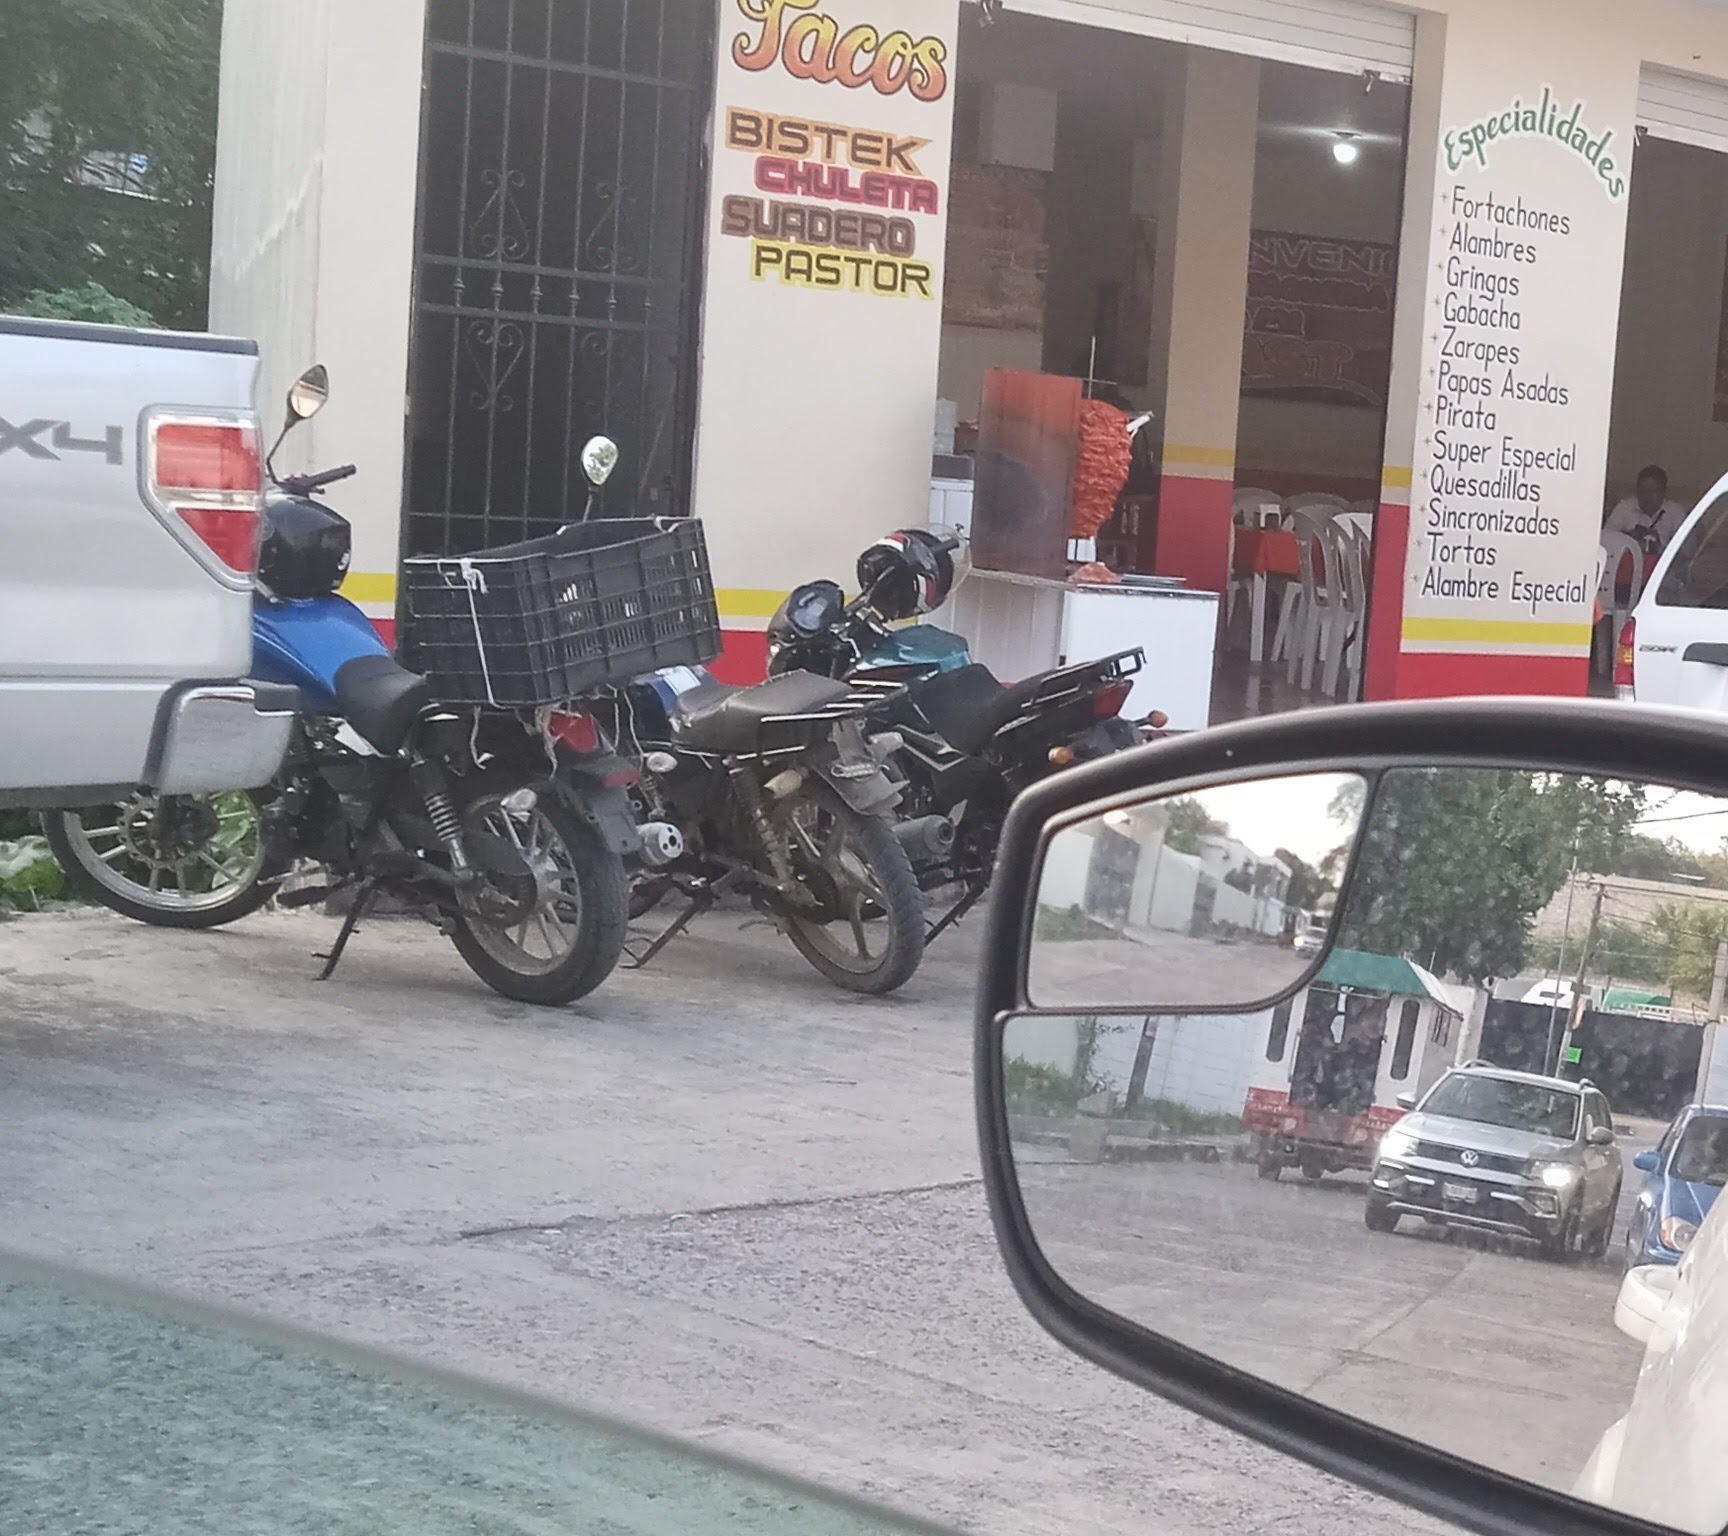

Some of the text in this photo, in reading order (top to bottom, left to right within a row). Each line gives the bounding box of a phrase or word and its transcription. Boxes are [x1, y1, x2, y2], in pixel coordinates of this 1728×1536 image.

[728, 110, 929, 173] BISTEK
[1444, 87, 1625, 198] Especialidades
[755, 156, 938, 214] CHULETA
[722, 197, 914, 256] SUADERO
[1451, 184, 1571, 236] Fortachones
[1449, 220, 1537, 264] Alambres
[754, 244, 931, 296] PASTOR
[1446, 255, 1520, 301] Gringas
[1443, 291, 1521, 331] Gabacha
[1441, 325, 1520, 372] Zarapes
[1437, 360, 1570, 405] Papas Asadas
[1435, 395, 1497, 431] Pirata
[1432, 429, 1577, 478] Super Especial
[1430, 464, 1541, 502] Quesadillas
[1427, 497, 1560, 536] Sincronizadas
[1426, 531, 1498, 566] Tortas
[1421, 566, 1588, 615] Alambre Especial
